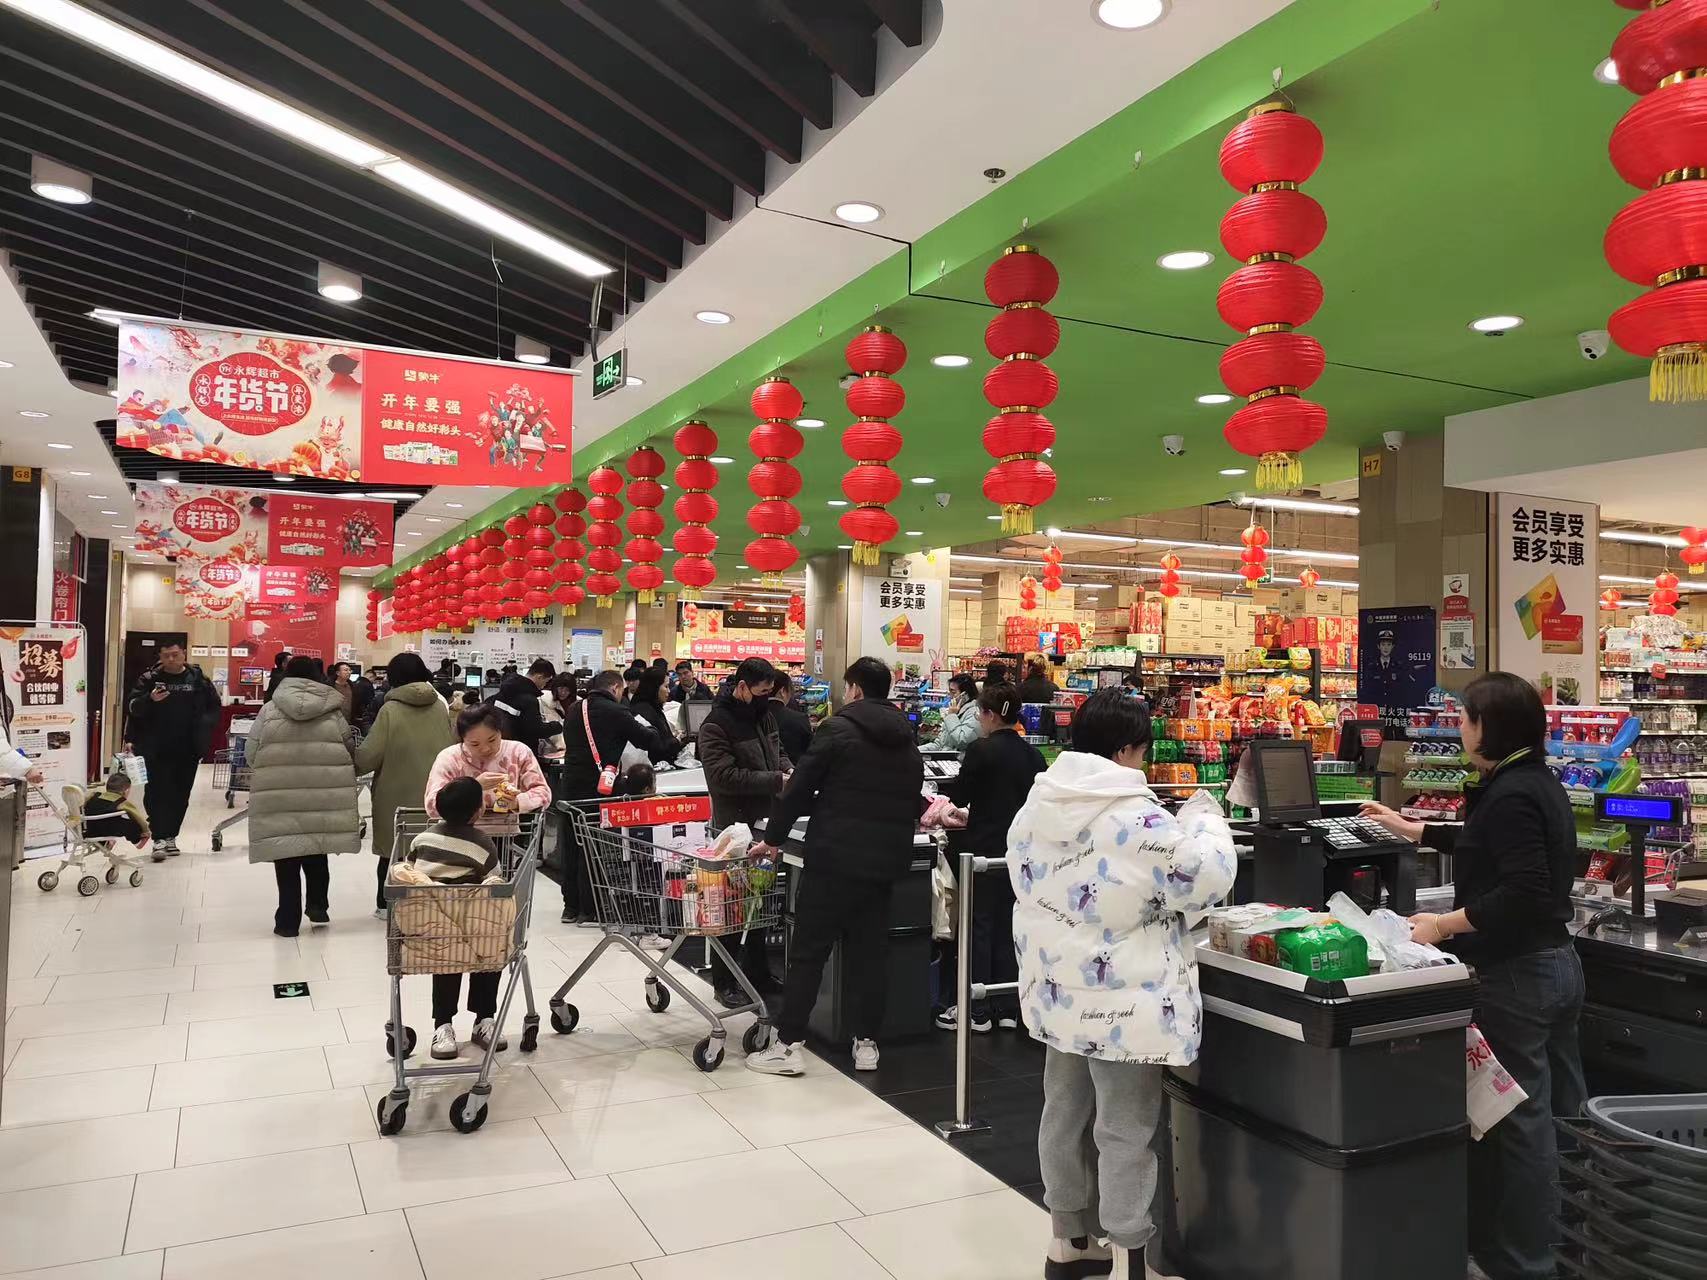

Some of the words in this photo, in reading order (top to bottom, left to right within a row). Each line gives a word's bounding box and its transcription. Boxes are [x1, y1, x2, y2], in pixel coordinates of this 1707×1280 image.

[234, 366, 279, 379] 永辉超市
[214, 375, 288, 413] 年货节
[381, 393, 461, 415] 开年要强
[380, 418, 461, 436] 健康自然好彩头
[1364, 459, 1379, 472] H7
[15, 470, 29, 479] G8
[186, 510, 228, 530] 年货节
[1512, 507, 1585, 539] 会员享受
[1512, 536, 1585, 566] 更多实惠
[880, 581, 926, 597] 会员享受
[880, 595, 926, 610] 更多实惠
[20, 642, 62, 680] 招募
[450, 650, 457, 659] 4
[510, 651, 516, 660] 3
[567, 653, 572, 661] 2
[1408, 652, 1432, 662] 96119
[1080, 1005, 1106, 1022] fashion
[1117, 1002, 1136, 1019] seek
